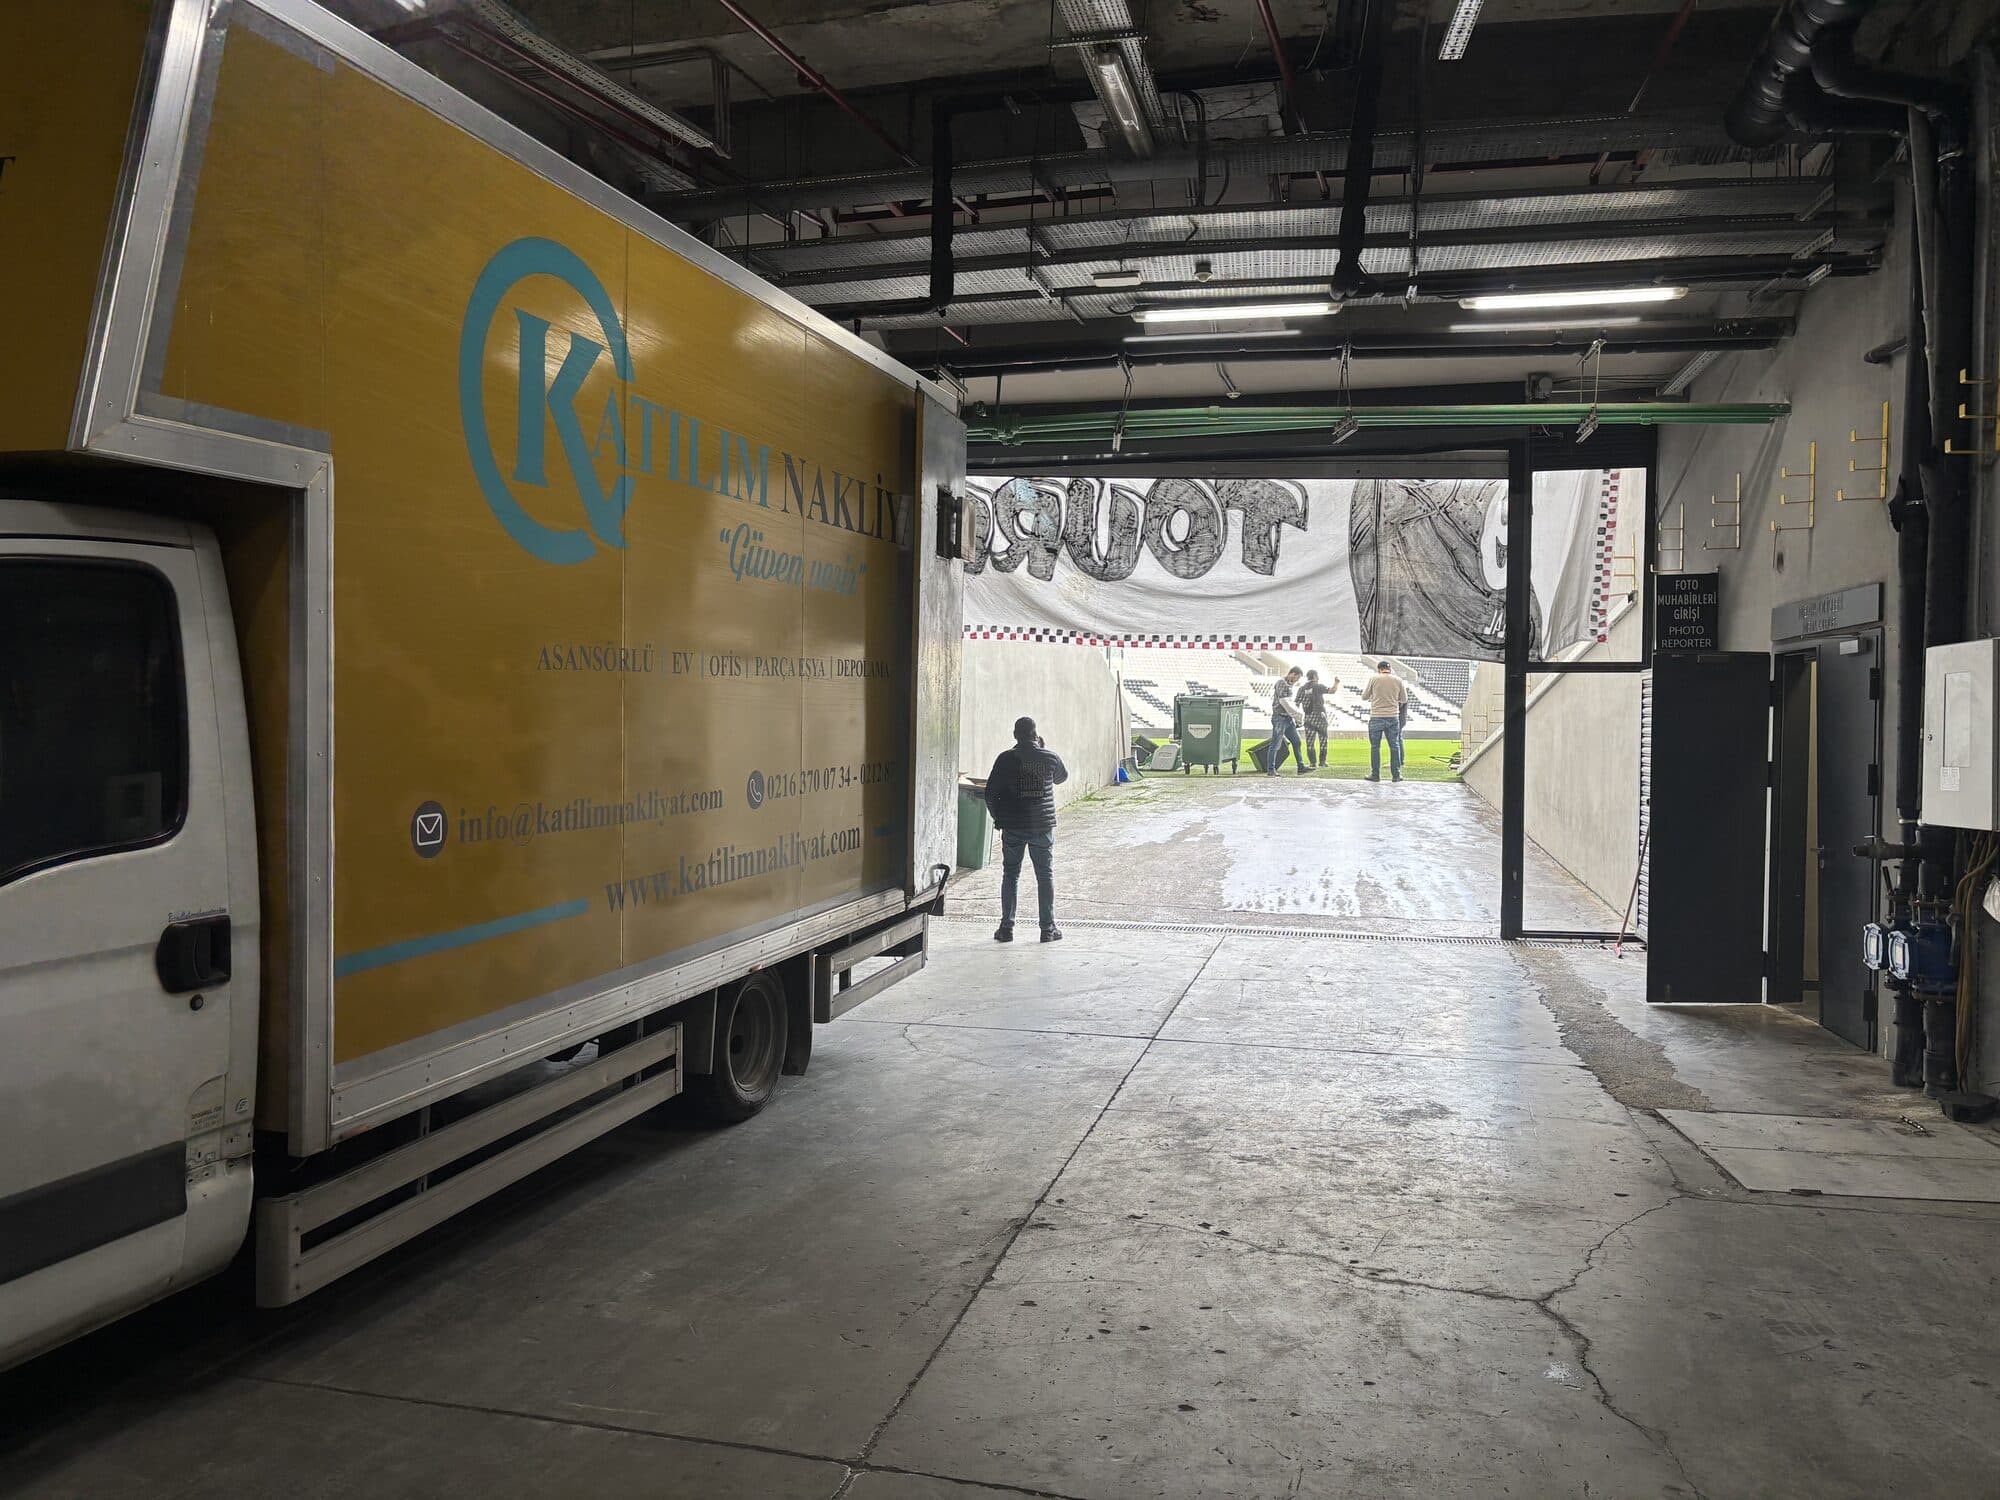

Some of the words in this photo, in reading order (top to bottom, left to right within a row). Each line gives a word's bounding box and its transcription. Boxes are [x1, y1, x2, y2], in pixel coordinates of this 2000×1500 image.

[1675, 579, 1699, 591] FOTO
[1657, 592, 1717, 606] MUHABİRLERİ
[1673, 606, 1700, 622] GİRİŞİ
[1669, 625, 1705, 635] PHOTO
[1661, 638, 1712, 648] REPORTER
[536, 641, 655, 673] ASANSÖRLÜ
[671, 651, 694, 675] EV
[709, 650, 742, 677] OFİS
[755, 655, 796, 681] PARÇA
[837, 658, 890, 679] DEPOLAMA
[767, 772, 796, 799] 0216
[799, 768, 820, 795] 370
[823, 766, 836, 791] 07
[838, 764, 851, 788] 34
[860, 761, 882, 785] 0212
[605, 825, 861, 913] www.katilimnakliyat.com
